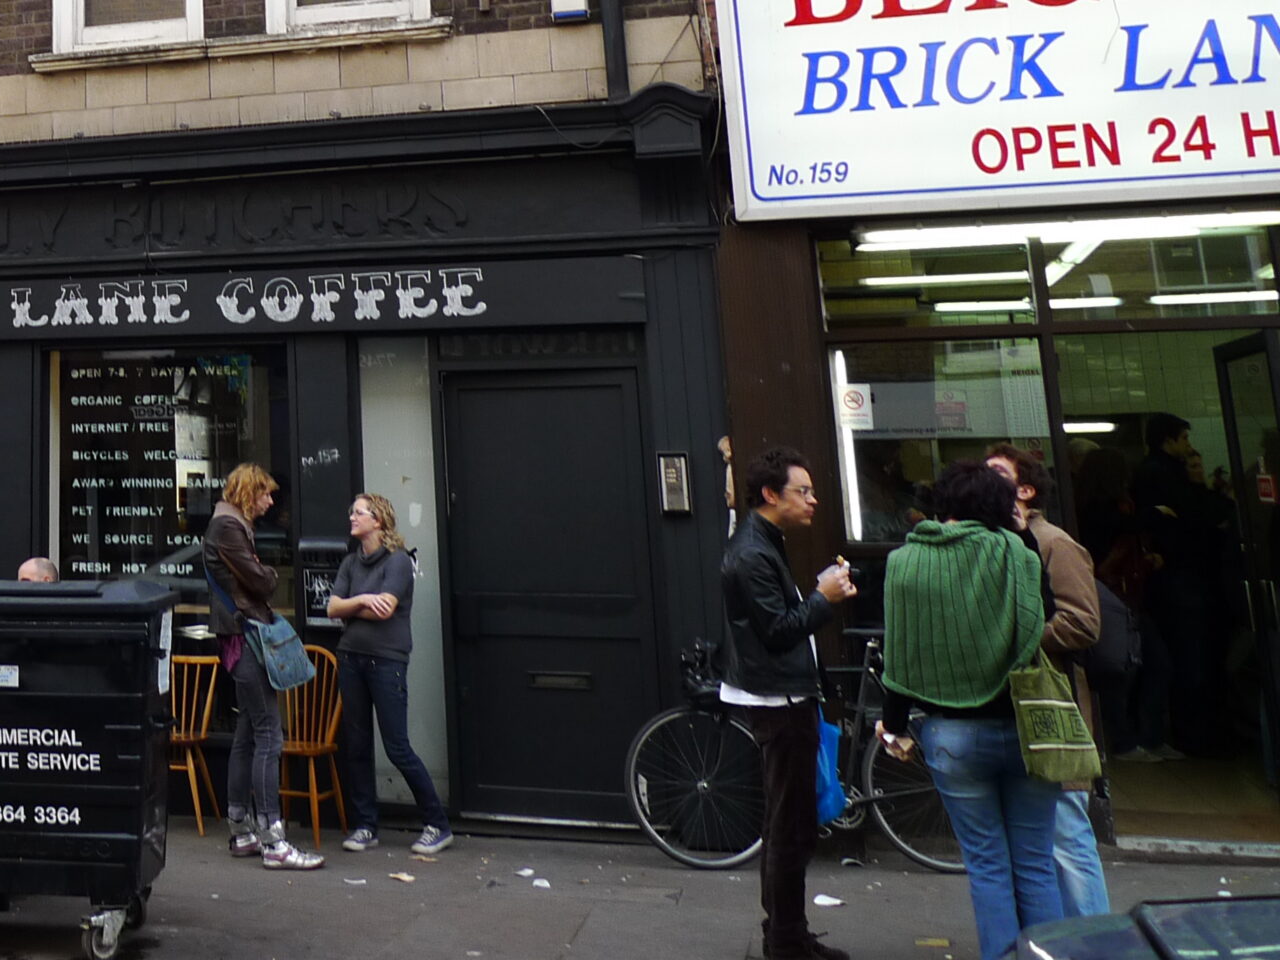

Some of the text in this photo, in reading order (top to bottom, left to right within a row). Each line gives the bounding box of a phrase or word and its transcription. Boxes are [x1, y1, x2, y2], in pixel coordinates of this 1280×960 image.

[794, 31, 1065, 116] BRICK
[972, 121, 1121, 175] OPEN
[1147, 115, 1216, 164] 24
[10, 278, 191, 330] LANE
[216, 267, 487, 326] COFFEE
[71, 368, 102, 379] OPEN
[189, 366, 198, 377] A
[71, 394, 179, 406] ORGANIC COFFEE
[71, 423, 130, 434] INTERNET
[139, 422, 170, 433] FREE
[72, 450, 130, 461] BICYCLES
[121, 477, 174, 488] WINNING
[186, 477, 227, 488] SANDW
[72, 506, 164, 517] PET FRIENDLY
[72, 534, 204, 545] WE SOURCE LOCA
[72, 562, 194, 574] FRESH HOT SOUP
[26, 753, 101, 771] SERVICE
[34, 806, 81, 824] 3364
